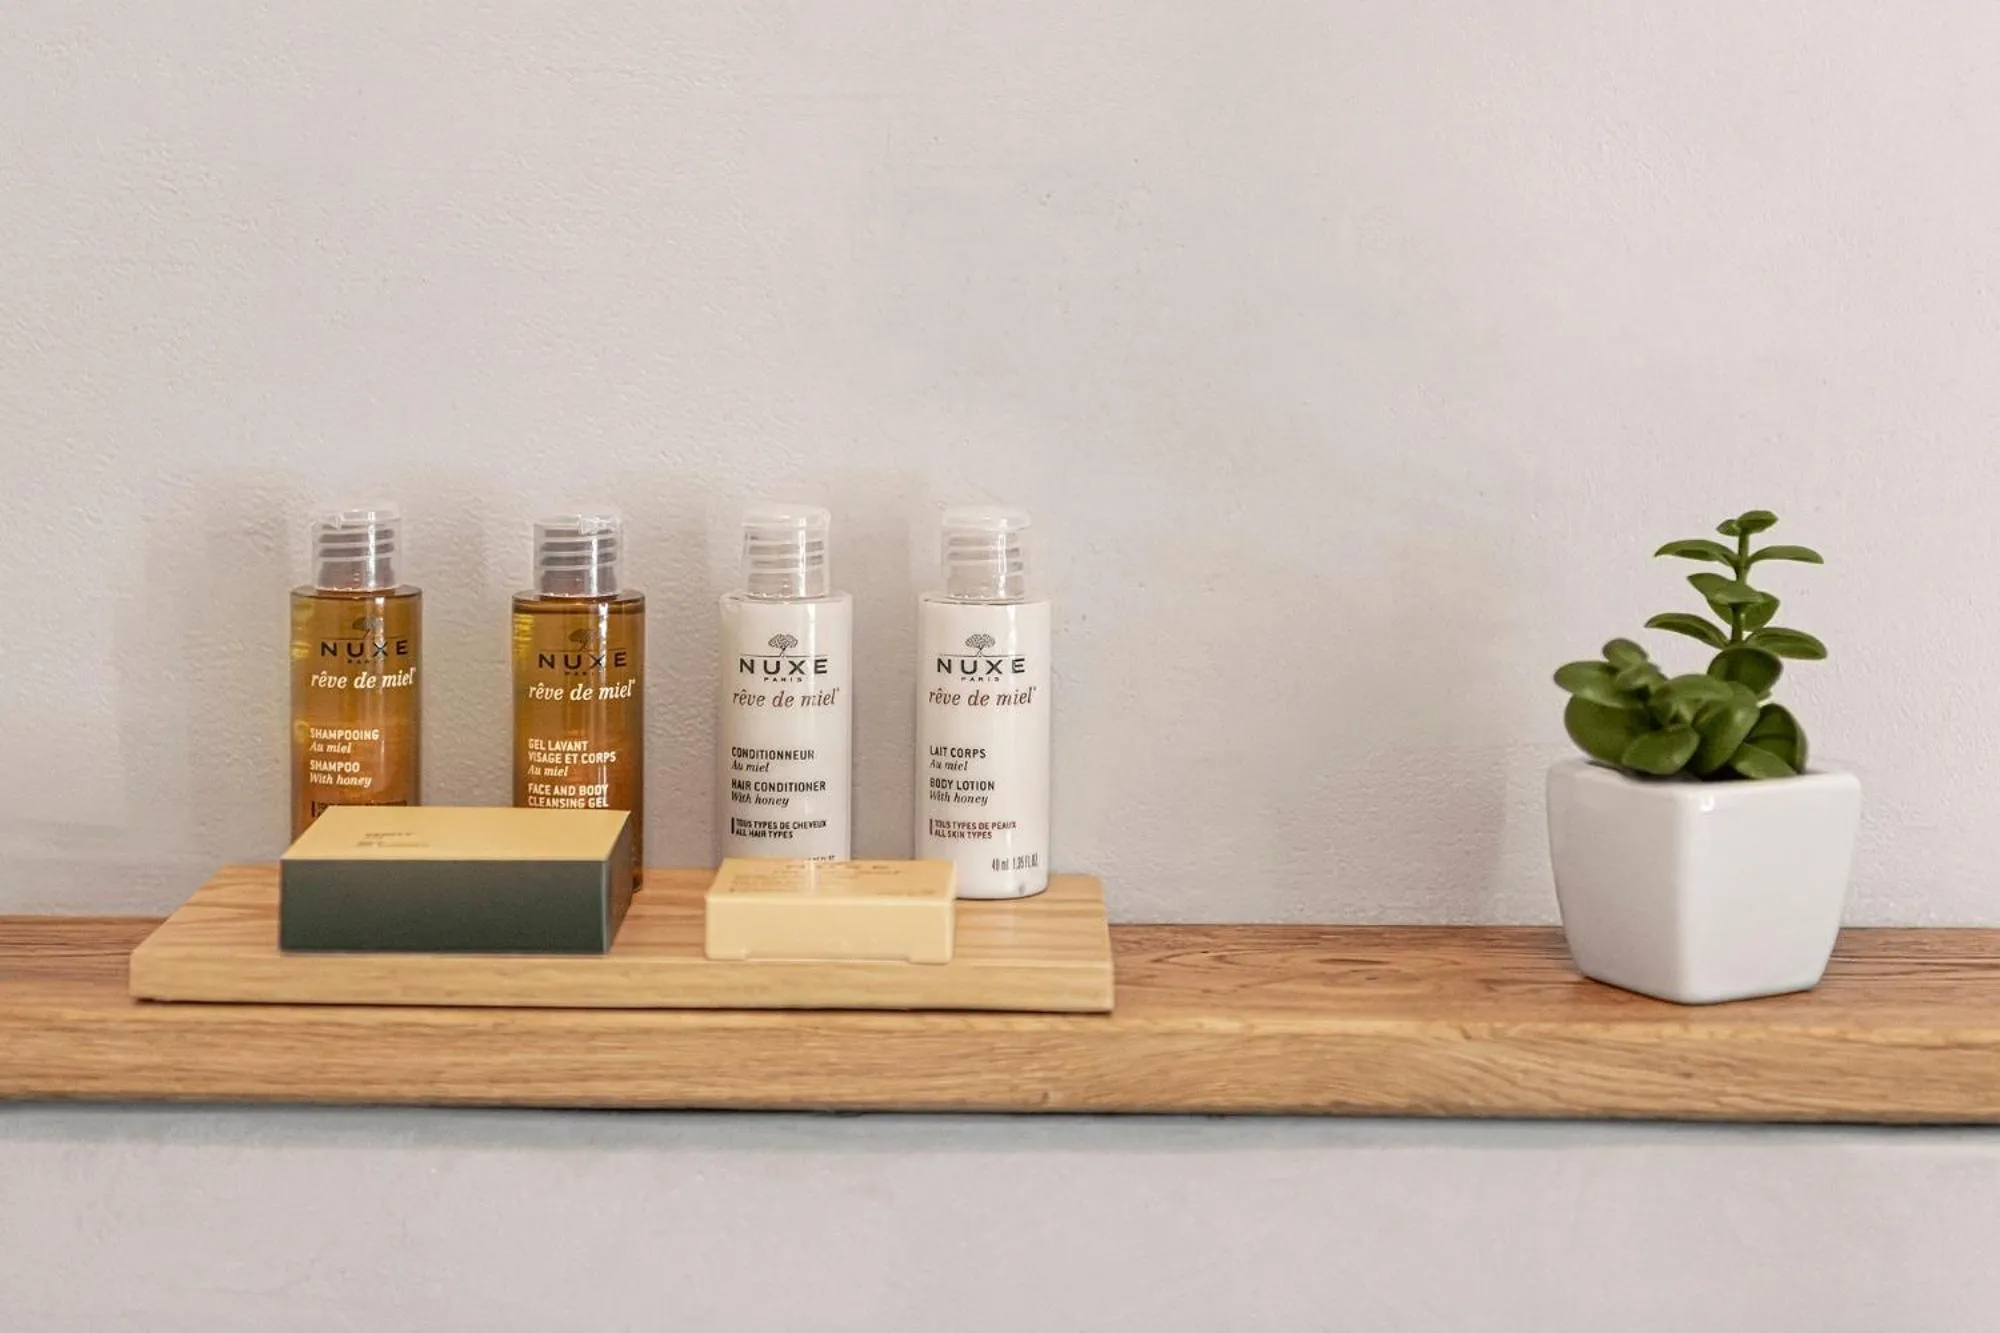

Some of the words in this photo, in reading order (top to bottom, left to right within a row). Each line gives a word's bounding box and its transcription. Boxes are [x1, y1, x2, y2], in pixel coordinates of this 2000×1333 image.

[320, 640, 409, 658] NUXE
[538, 651, 627, 670] NUXE
[739, 658, 828, 675] NUXE
[936, 658, 1025, 675] NUXE
[311, 670, 348, 689] rêve
[353, 671, 377, 689] de
[528, 682, 564, 700] rêve
[569, 683, 593, 701] de
[598, 680, 634, 700] miel
[732, 688, 766, 706] rêve
[771, 690, 795, 708] de
[928, 688, 961, 706] rêve
[967, 689, 990, 707] de
[995, 685, 1033, 706] miel
[309, 727, 380, 741] SHAMPOOING
[326, 741, 352, 754] miel
[528, 738, 546, 751] GEL
[547, 739, 589, 752] LAVANT
[929, 745, 948, 757] LAIT
[950, 747, 987, 759] CORPS
[528, 750, 562, 764] VISAGE
[564, 752, 579, 765] ET
[581, 750, 617, 765] CORPS
[731, 746, 815, 761] CONDITIONNEUR
[309, 759, 361, 774] SHAMPOO
[543, 765, 569, 777] miel
[745, 762, 770, 773] miel
[944, 760, 969, 771] miel
[309, 772, 333, 785] With
[335, 774, 373, 788] honey
[731, 779, 752, 791] HAIR
[753, 780, 827, 793] CONDITIONER
[929, 777, 954, 790] BODY
[956, 780, 996, 792] LOTION
[528, 783, 552, 796] FACE
[553, 784, 577, 797] AND
[578, 783, 609, 797] BODY
[528, 795, 585, 809] CLEANSING
[587, 797, 610, 809] GEL
[754, 794, 790, 809] honey
[953, 792, 989, 807] honey
[779, 821, 790, 830] DE
[952, 821, 977, 830] TYPES
[978, 821, 989, 830] DE
[748, 829, 766, 838] HAIR
[768, 830, 793, 839] TYPES
[947, 830, 965, 839] SKIN
[967, 831, 993, 840] TYPES
